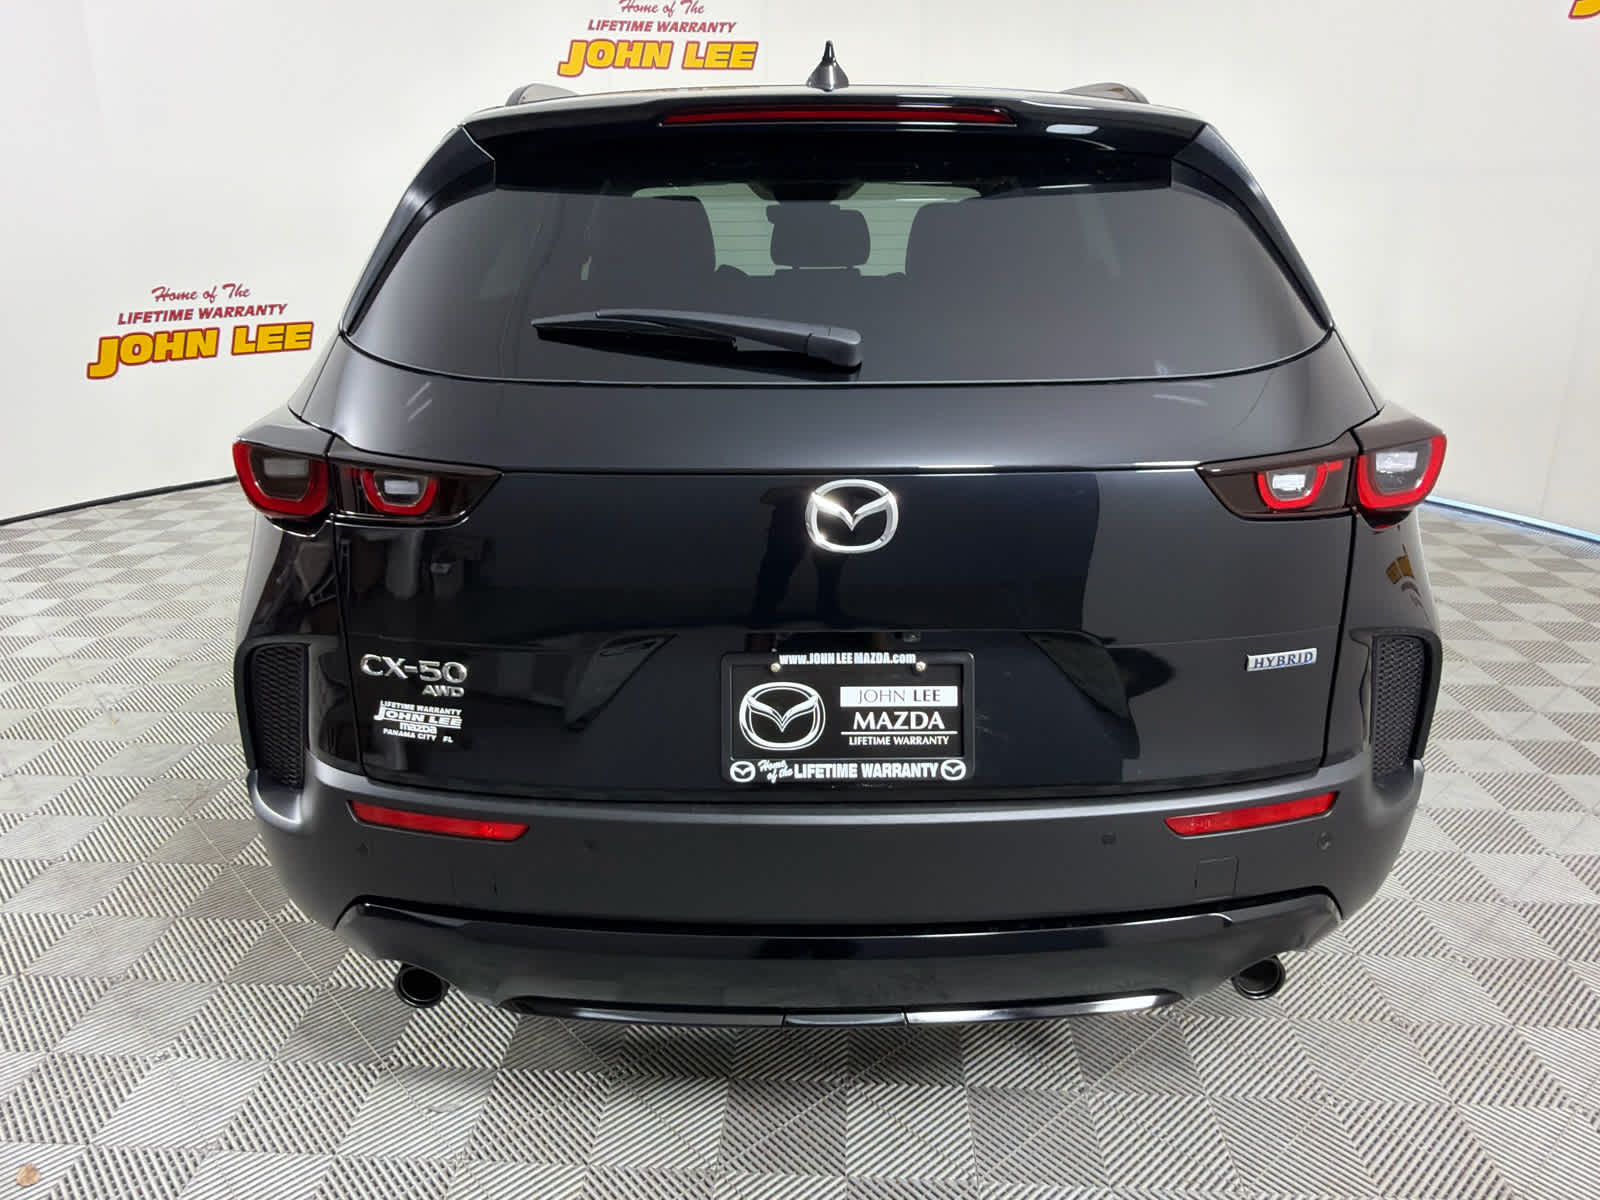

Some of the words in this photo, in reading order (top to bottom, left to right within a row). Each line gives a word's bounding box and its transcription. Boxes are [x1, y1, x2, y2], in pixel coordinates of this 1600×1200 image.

[618, 0, 658, 14] Home
[662, 2, 675, 17] of
[680, 0, 704, 14] The
[588, 19, 653, 32] LIFETIME
[657, 20, 737, 33] WARRANTY
[557, 39, 674, 77] JOHN
[682, 41, 759, 70] LEE
[151, 286, 198, 302] Home
[202, 286, 217, 303] of
[222, 283, 251, 299] The
[117, 309, 194, 326] LIFETIME
[199, 303, 288, 320] WARRANTY
[86, 327, 220, 380] JOHN
[231, 321, 314, 355] LEE
[360, 653, 468, 683] CX-50
[1254, 651, 1314, 669] HYBRID
[422, 684, 465, 697] AWD
[858, 689, 906, 704] JOHN
[913, 689, 941, 702] LEE
[380, 700, 415, 711] LIFETIME
[416, 704, 462, 715] WARRANTY
[428, 715, 463, 727] LEE
[853, 711, 945, 730] MAZDA
[383, 728, 416, 739] PANAMA
[417, 733, 437, 742] CITY
[849, 736, 891, 745] LIFETIME
[893, 735, 949, 745] WARRANTY
[794, 763, 858, 779] LIFETIME
[861, 763, 938, 779] WARRANTY
